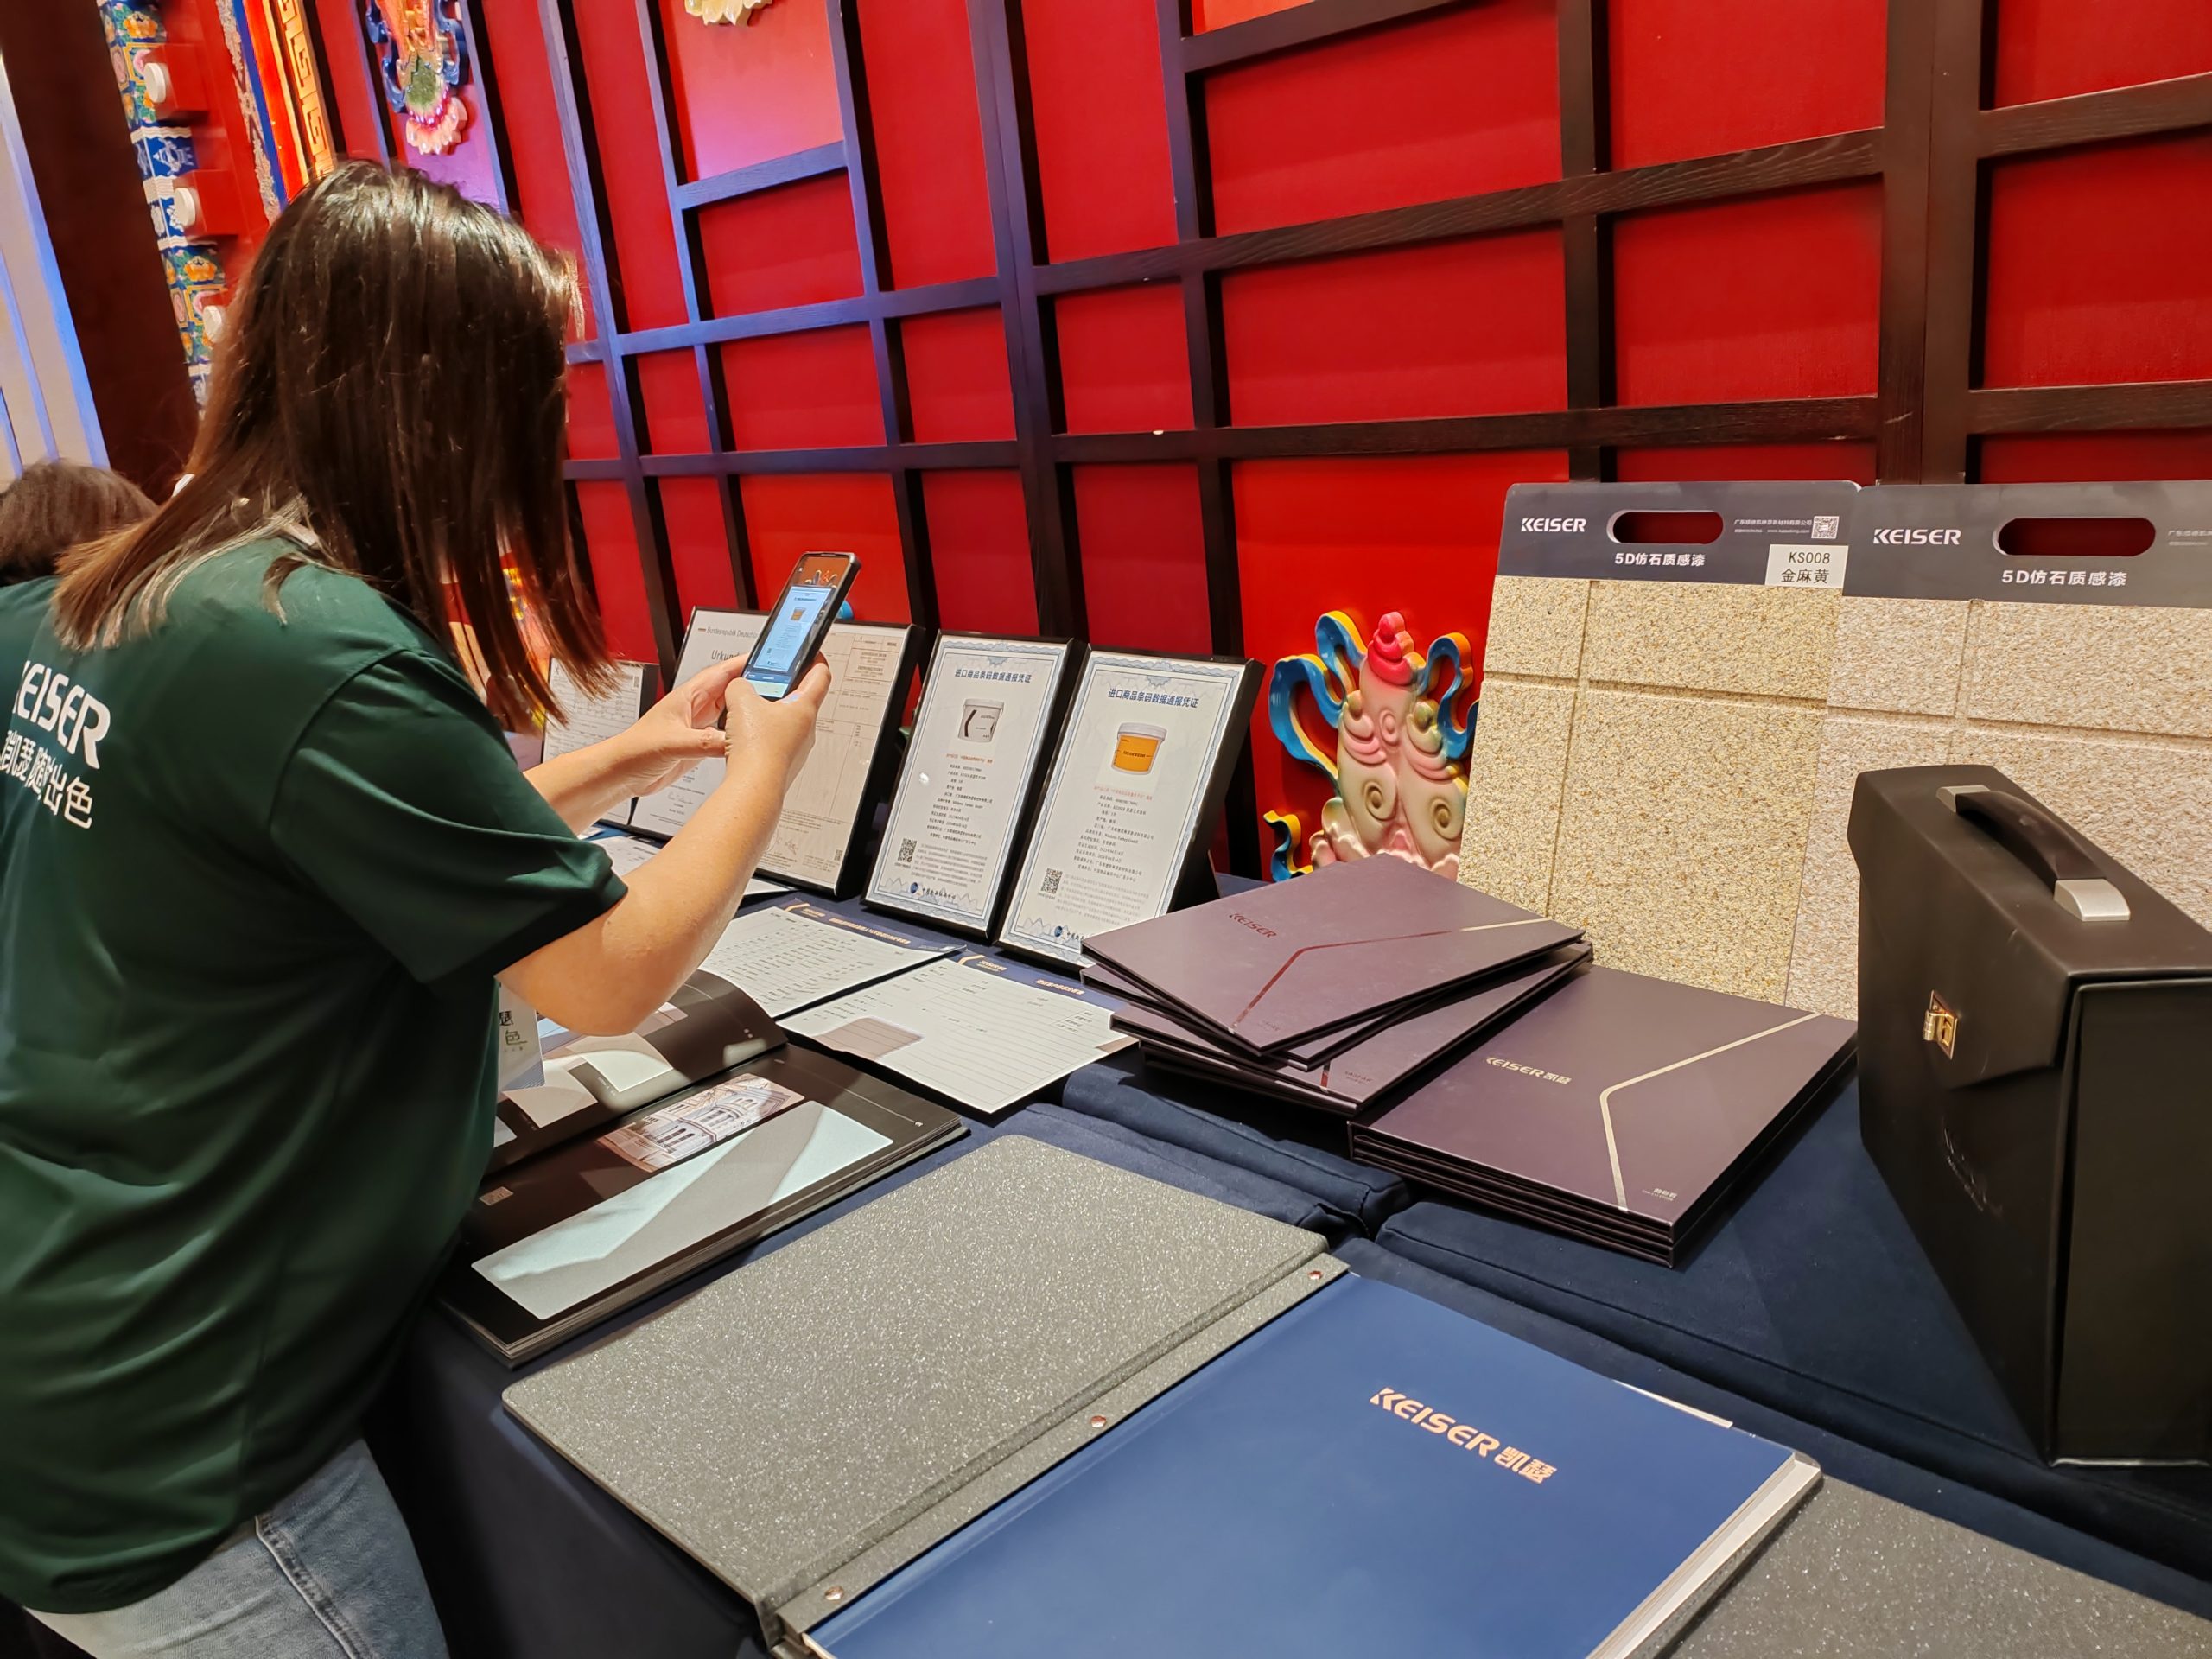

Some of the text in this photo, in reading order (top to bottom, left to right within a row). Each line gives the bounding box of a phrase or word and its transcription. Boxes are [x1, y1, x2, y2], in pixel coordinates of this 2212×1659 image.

[1521, 518, 1587, 532] KEISER
[1873, 528, 1961, 545] KEISER
[1614, 552, 1706, 567] 5D仿石质感漆
[1788, 551, 1831, 564] KS008
[1781, 568, 1830, 584] 金麻黄
[2001, 569, 2128, 587] 5D仿石质感漆
[1108, 688, 1199, 709] 进口商品条码数据通报凭证
[1229, 912, 1277, 938] KEISER
[1484, 1057, 1544, 1077] KEISER
[1369, 1387, 1558, 1484] KEISER 凯瑟
